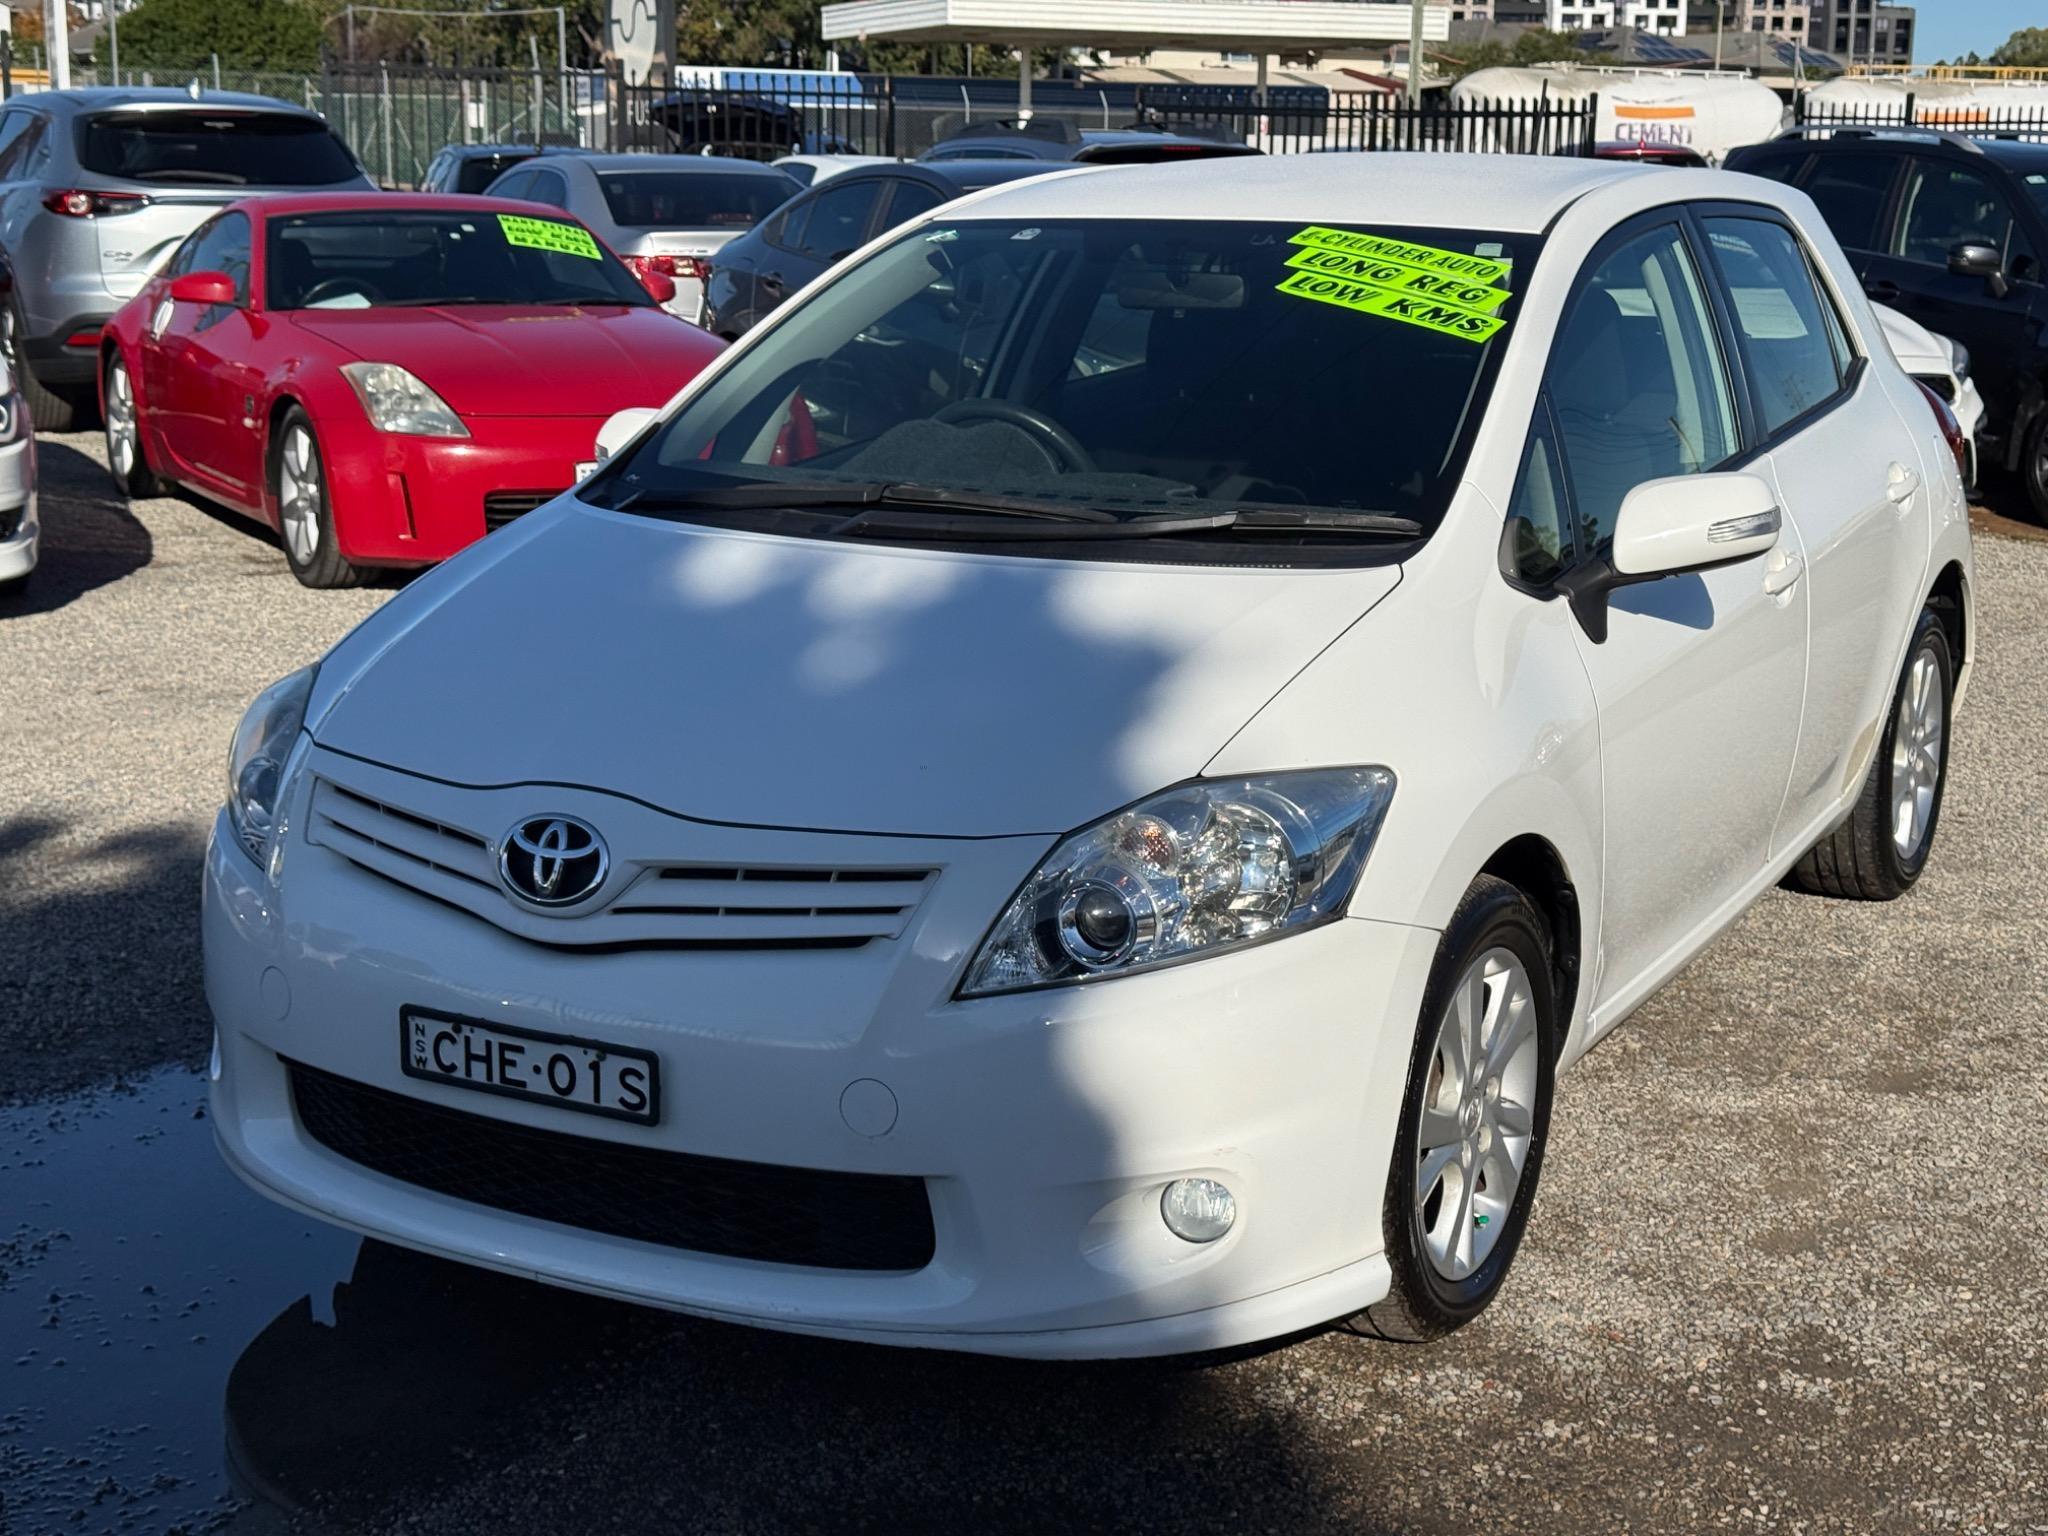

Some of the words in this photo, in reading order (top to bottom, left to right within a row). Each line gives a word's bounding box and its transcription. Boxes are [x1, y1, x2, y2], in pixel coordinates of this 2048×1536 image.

[514, 236, 597, 257] MANUAL
[1299, 230, 1433, 263] 4-CYLINDER
[1430, 255, 1502, 278] AUTO
[1299, 252, 1404, 281] LONG
[1406, 273, 1493, 304] REG
[1289, 275, 1384, 304] LOW
[1382, 297, 1493, 335] KMS
[414, 1023, 428, 1070] NSW
